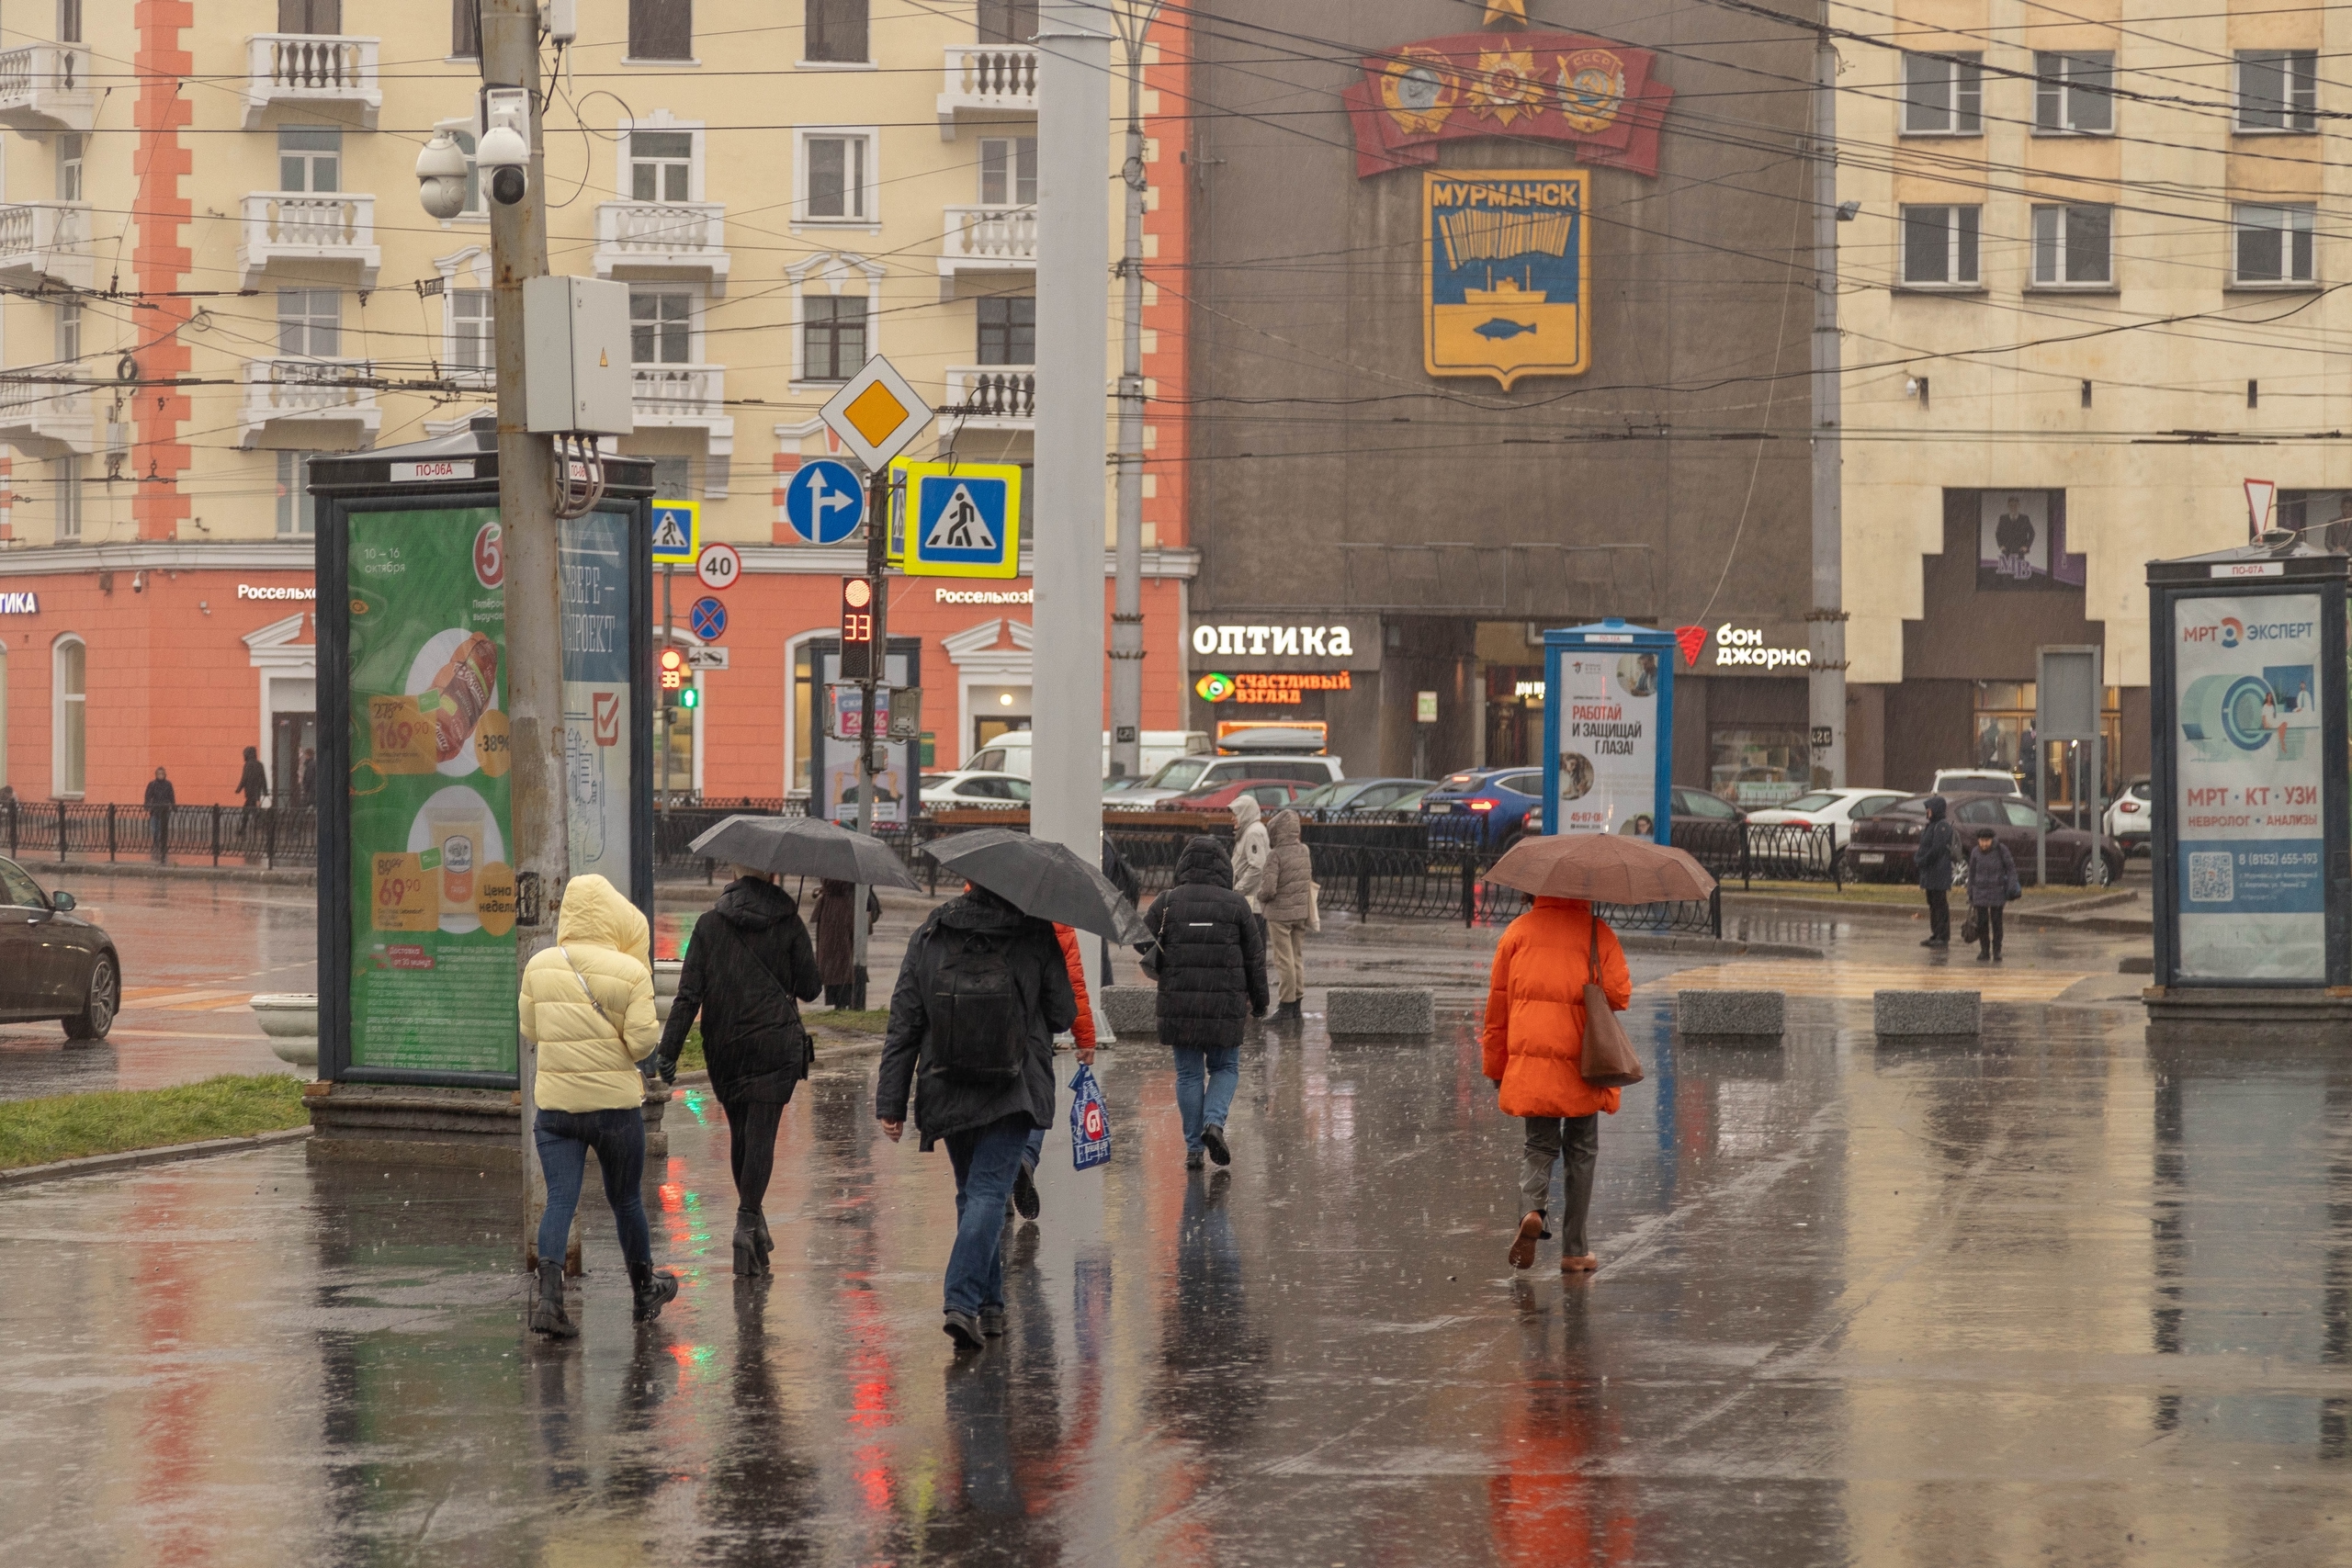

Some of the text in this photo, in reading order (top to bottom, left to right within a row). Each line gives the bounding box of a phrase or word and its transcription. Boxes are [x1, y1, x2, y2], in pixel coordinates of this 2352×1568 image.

[1573, 52, 1611, 67] СССР
[1433, 184, 1578, 208] МУРМАНСК
[415, 463, 453, 477] ПО-06А
[365, 548, 376, 558] 10
[390, 547, 401, 558] 16
[365, 561, 406, 574] октября
[706, 558, 731, 575] 40
[2232, 566, 2264, 575] ПО-07А
[844, 615, 871, 640] 33
[1716, 623, 1762, 646] бон
[2184, 622, 2313, 642] МРТ ЭКСПЕРТ
[1193, 626, 1353, 657] оптика
[1716, 647, 1811, 671] джорно
[662, 671, 680, 688] 33
[1572, 704, 1623, 720] РАБОТАЙ
[1572, 721, 1642, 739] И ЗАЩИЩАЙ
[1594, 740, 1634, 755] ГЛАЗА!
[2188, 785, 2317, 807] МРТ КТ УЗИ
[2188, 814, 2317, 827] НЕВРОЛОГ АНАЛИЗЫ
[2239, 852, 2318, 866] 8 (8152) 655-193
[484, 885, 512, 898] Цена
